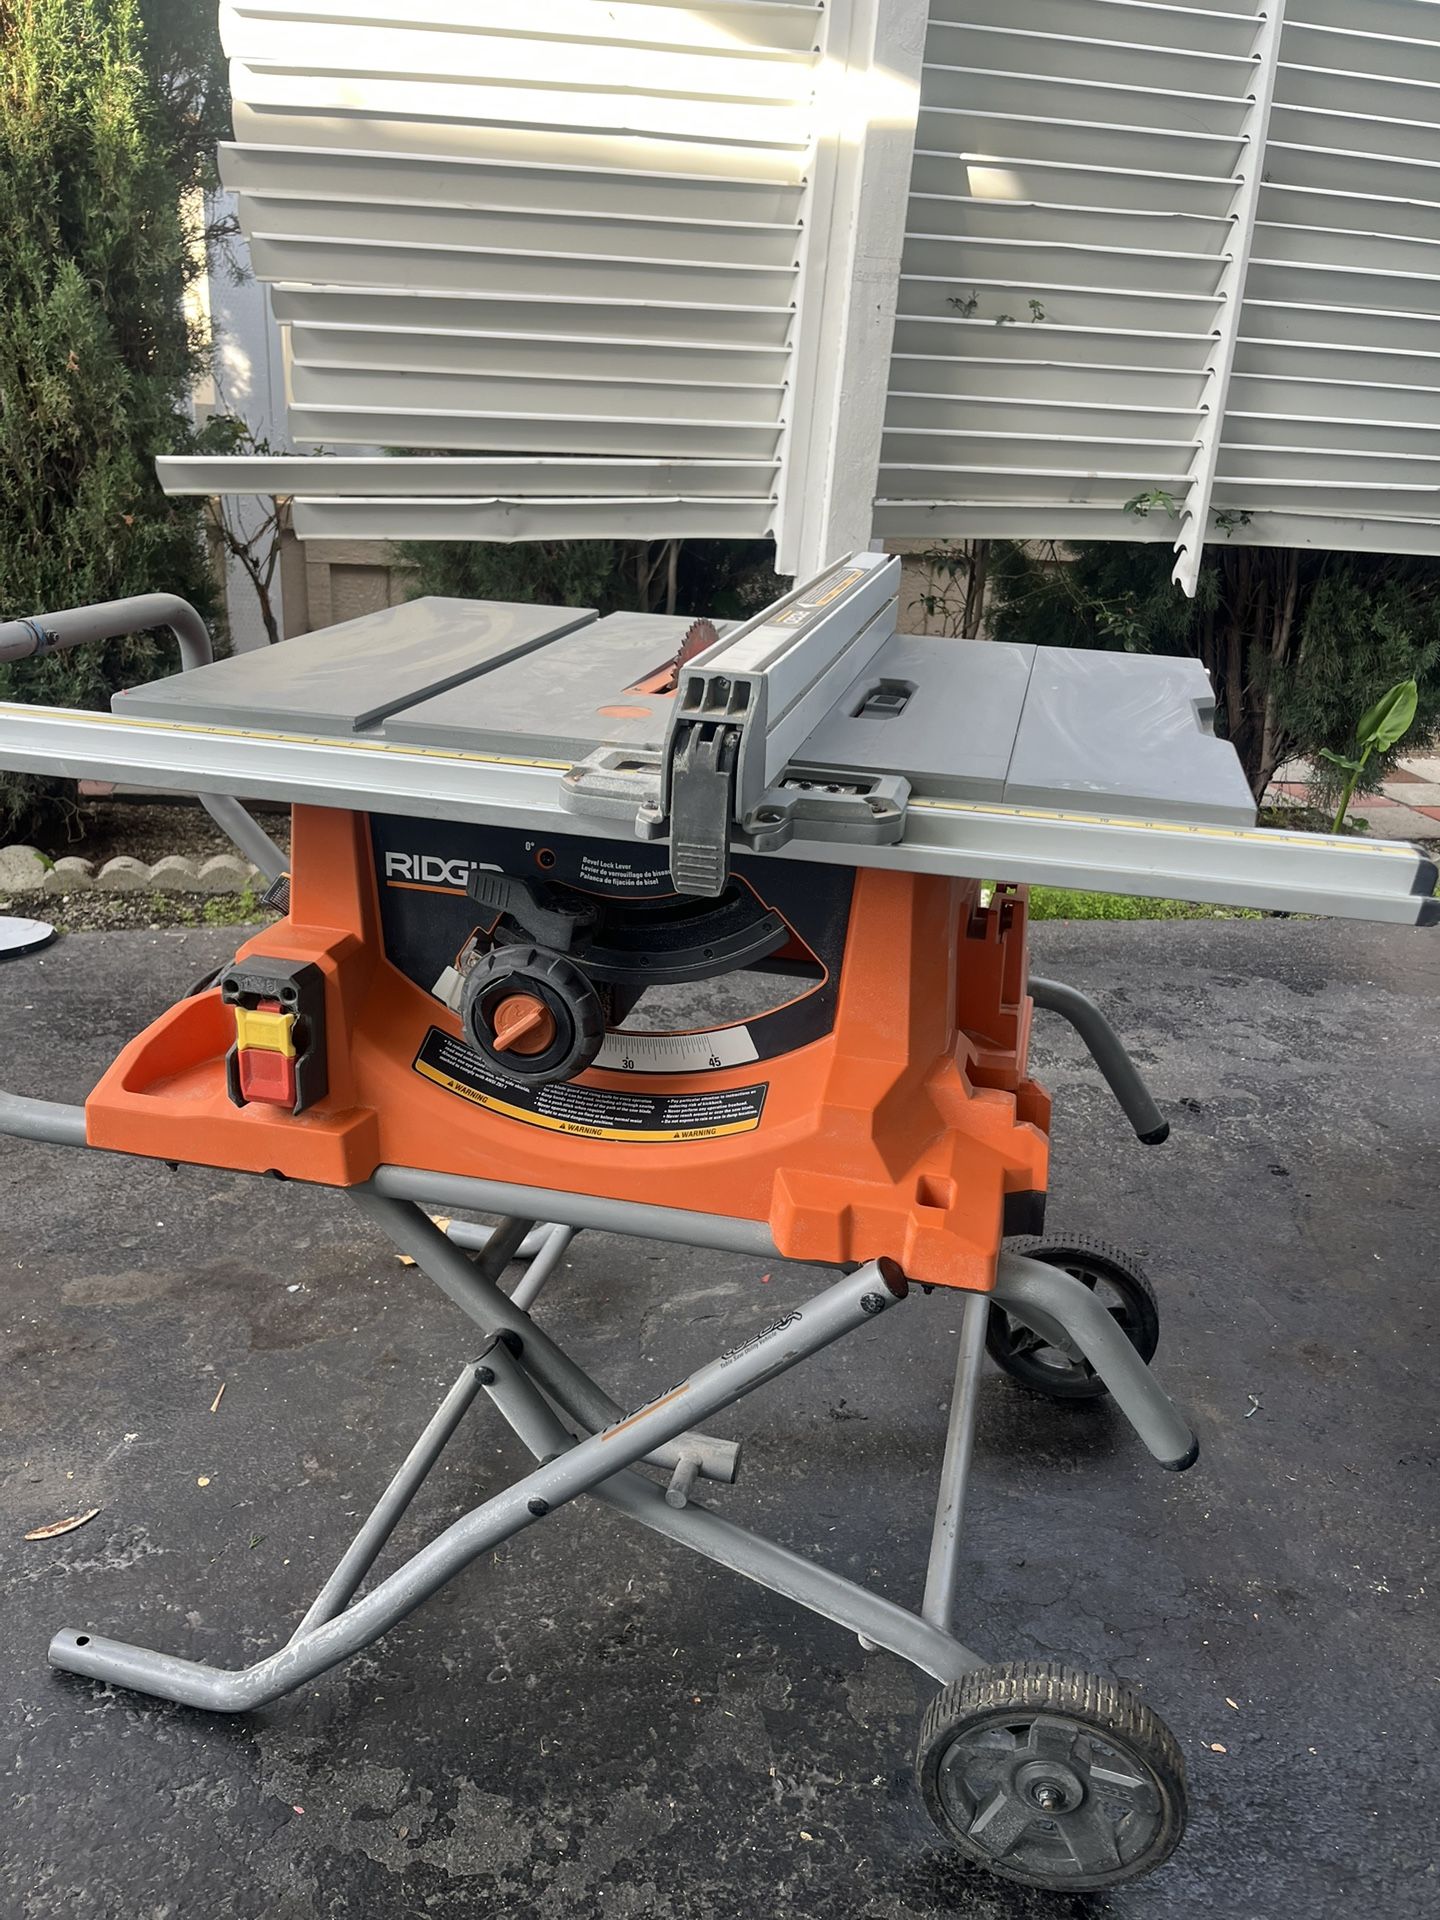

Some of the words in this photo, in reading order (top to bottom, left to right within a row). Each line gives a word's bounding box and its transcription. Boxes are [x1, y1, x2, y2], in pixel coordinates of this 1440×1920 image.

[582, 856, 599, 866] Bevel
[600, 860, 614, 868] Lock
[385, 851, 505, 886] RIDG
[581, 864, 599, 873] Levier
[579, 871, 603, 882] Palanca
[622, 1060, 635, 1069] 30
[708, 1057, 721, 1067] 45
[453, 1082, 489, 1104] WARNING
[567, 1124, 603, 1135] WARNING
[681, 1128, 717, 1138] WARNING
[720, 1358, 732, 1368] Table
[733, 1352, 744, 1361] Saw
[744, 1344, 758, 1354] Utility
[758, 1331, 776, 1344] Vehicle
